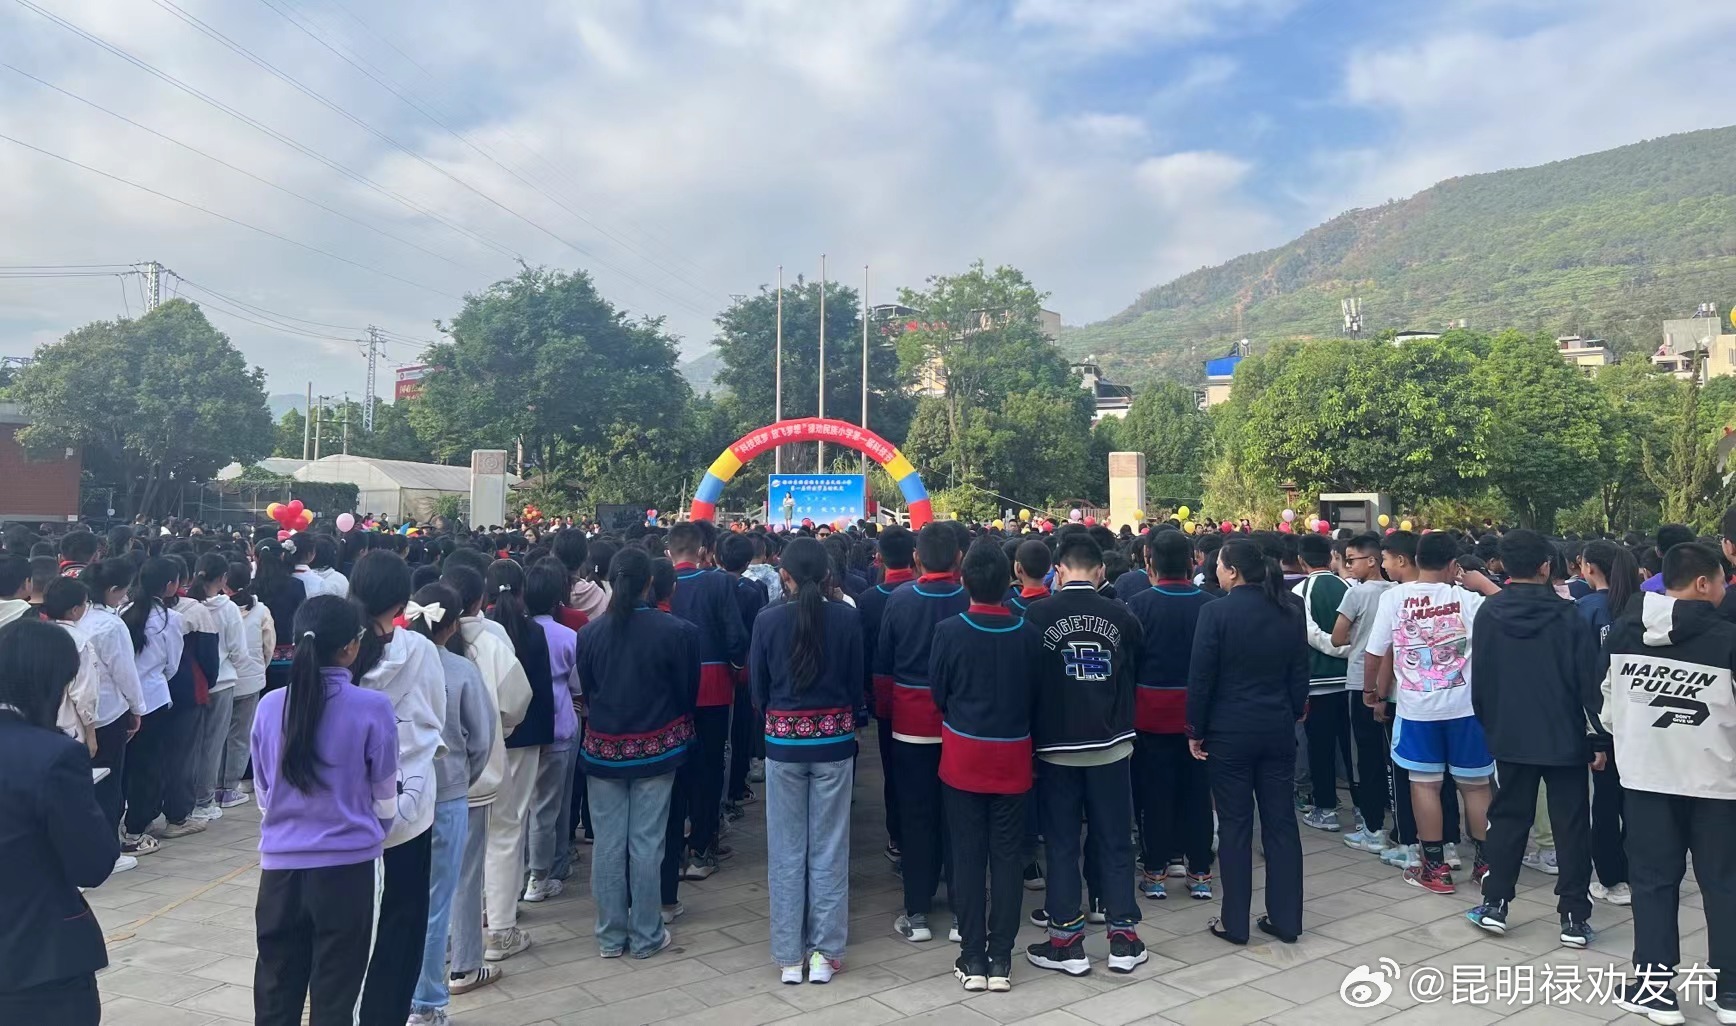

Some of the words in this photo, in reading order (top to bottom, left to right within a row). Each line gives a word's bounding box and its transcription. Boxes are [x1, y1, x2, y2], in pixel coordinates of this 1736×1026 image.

[1420, 596, 1431, 607] A
[1620, 662, 1717, 687] MARCIN
[1630, 677, 1704, 699] PULIK
